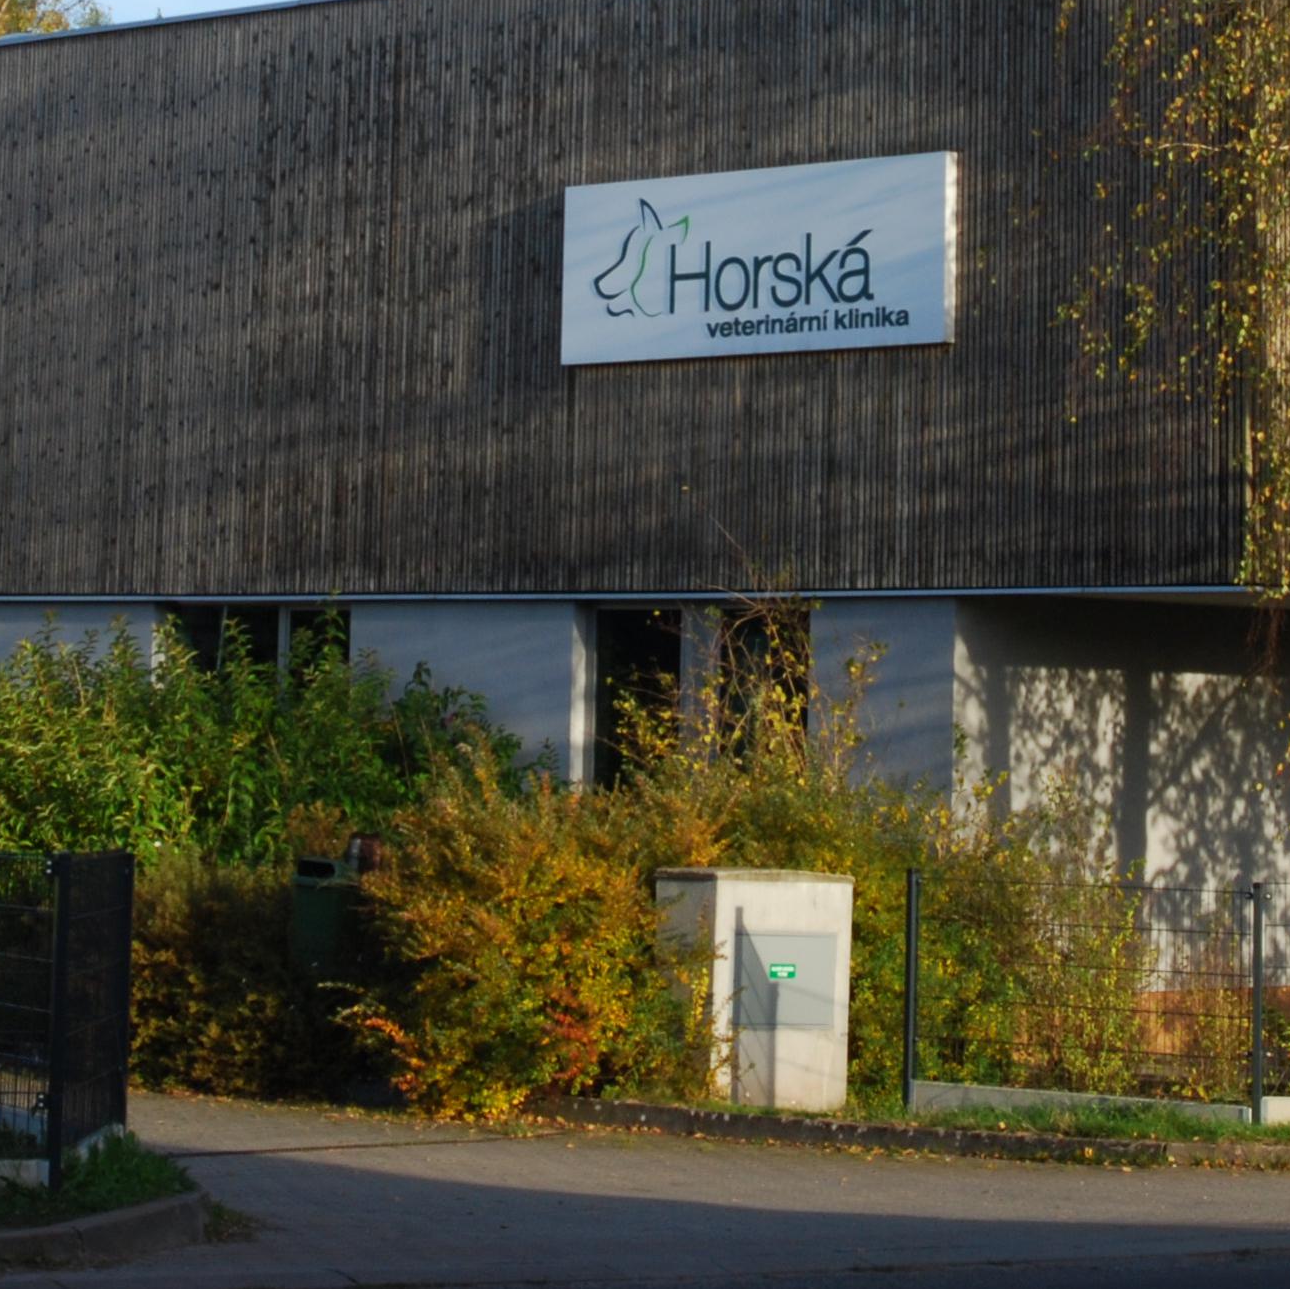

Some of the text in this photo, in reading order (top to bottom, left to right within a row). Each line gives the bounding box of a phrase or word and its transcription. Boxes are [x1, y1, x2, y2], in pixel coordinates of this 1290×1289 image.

[669, 229, 875, 315] Horská
[707, 306, 910, 338] veterinární klinika
